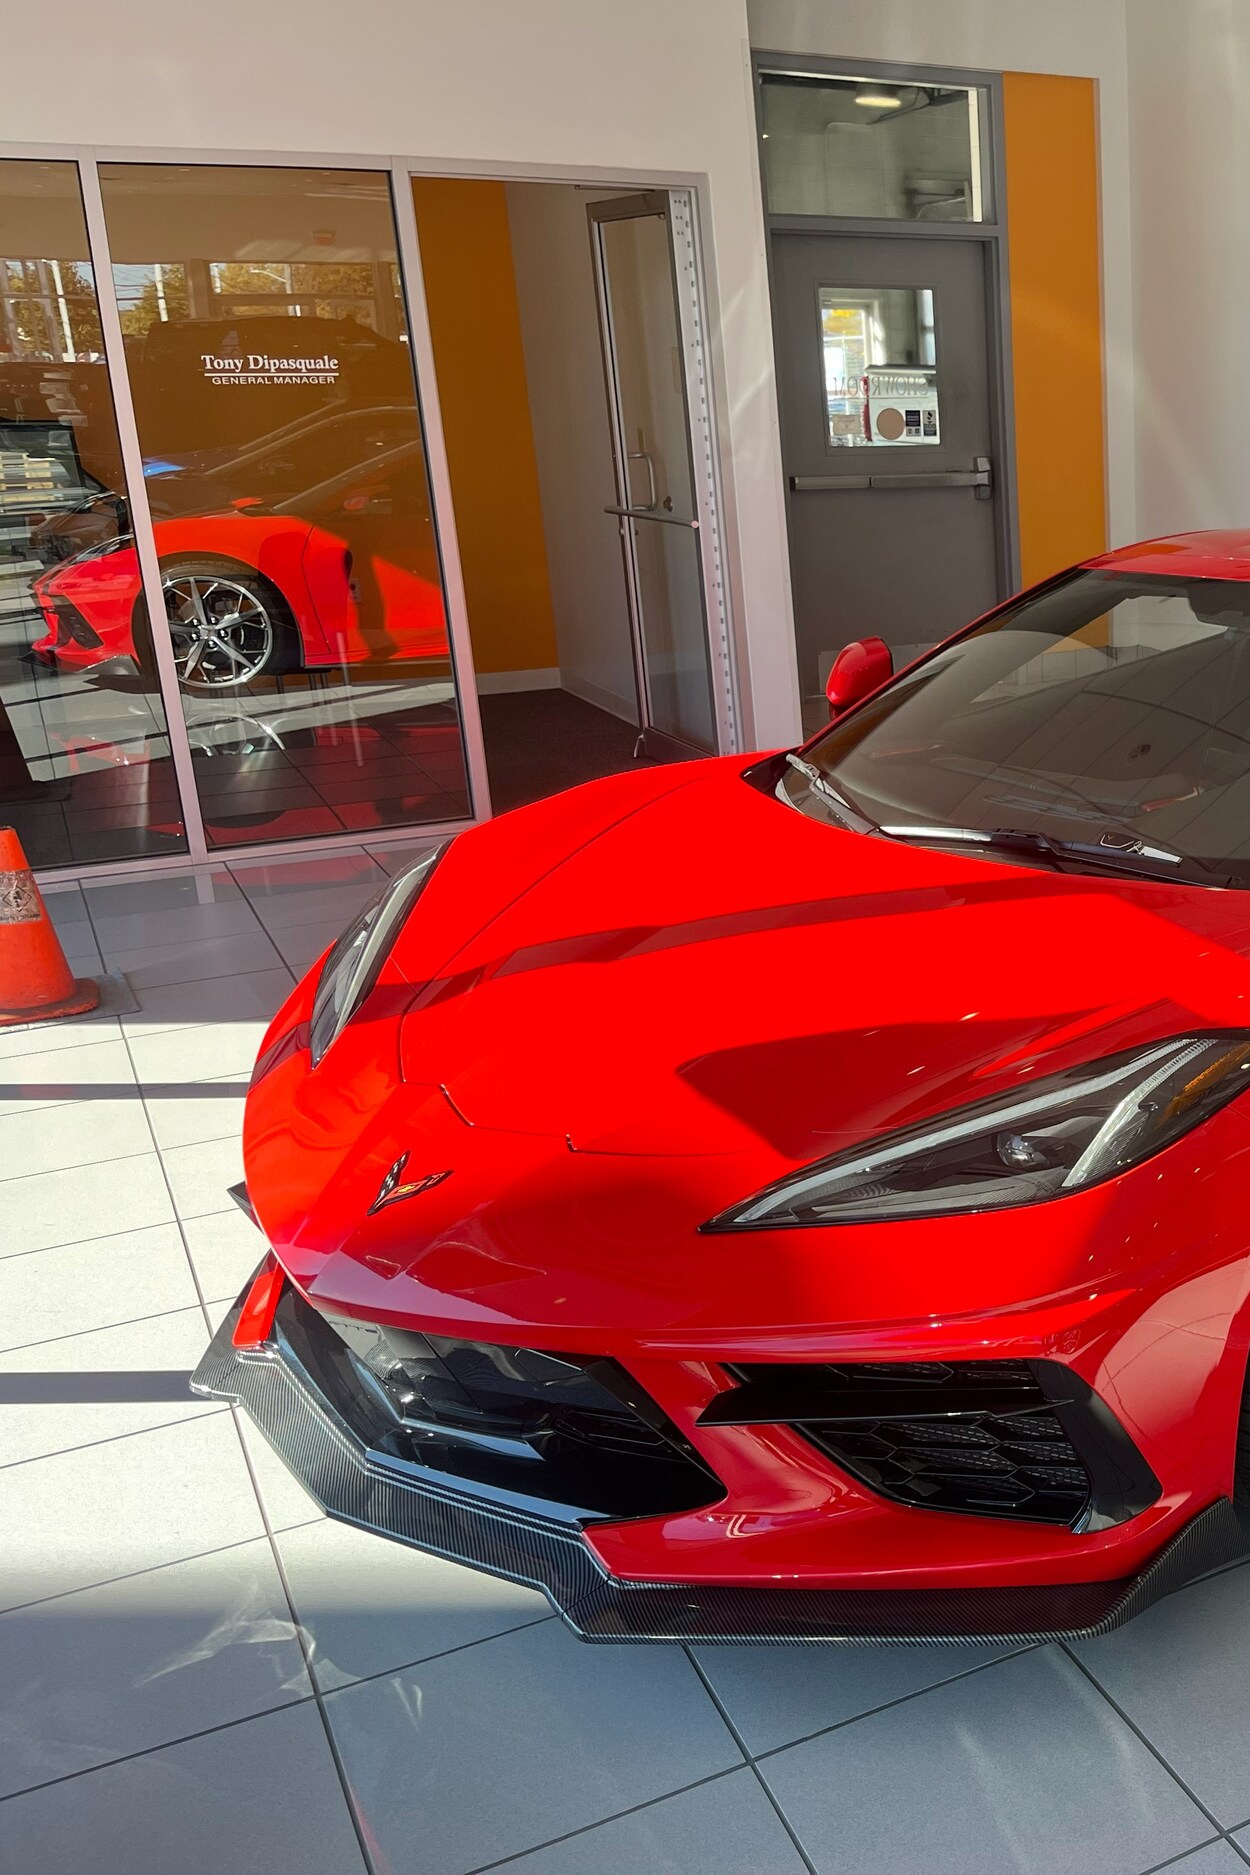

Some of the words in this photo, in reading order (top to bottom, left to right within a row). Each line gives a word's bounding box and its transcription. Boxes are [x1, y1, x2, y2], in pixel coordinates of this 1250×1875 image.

[201, 354, 243, 373] Tony
[247, 354, 339, 373] Dipasquale
[212, 376, 272, 385] GENERAL
[274, 376, 335, 385] MANAGER
